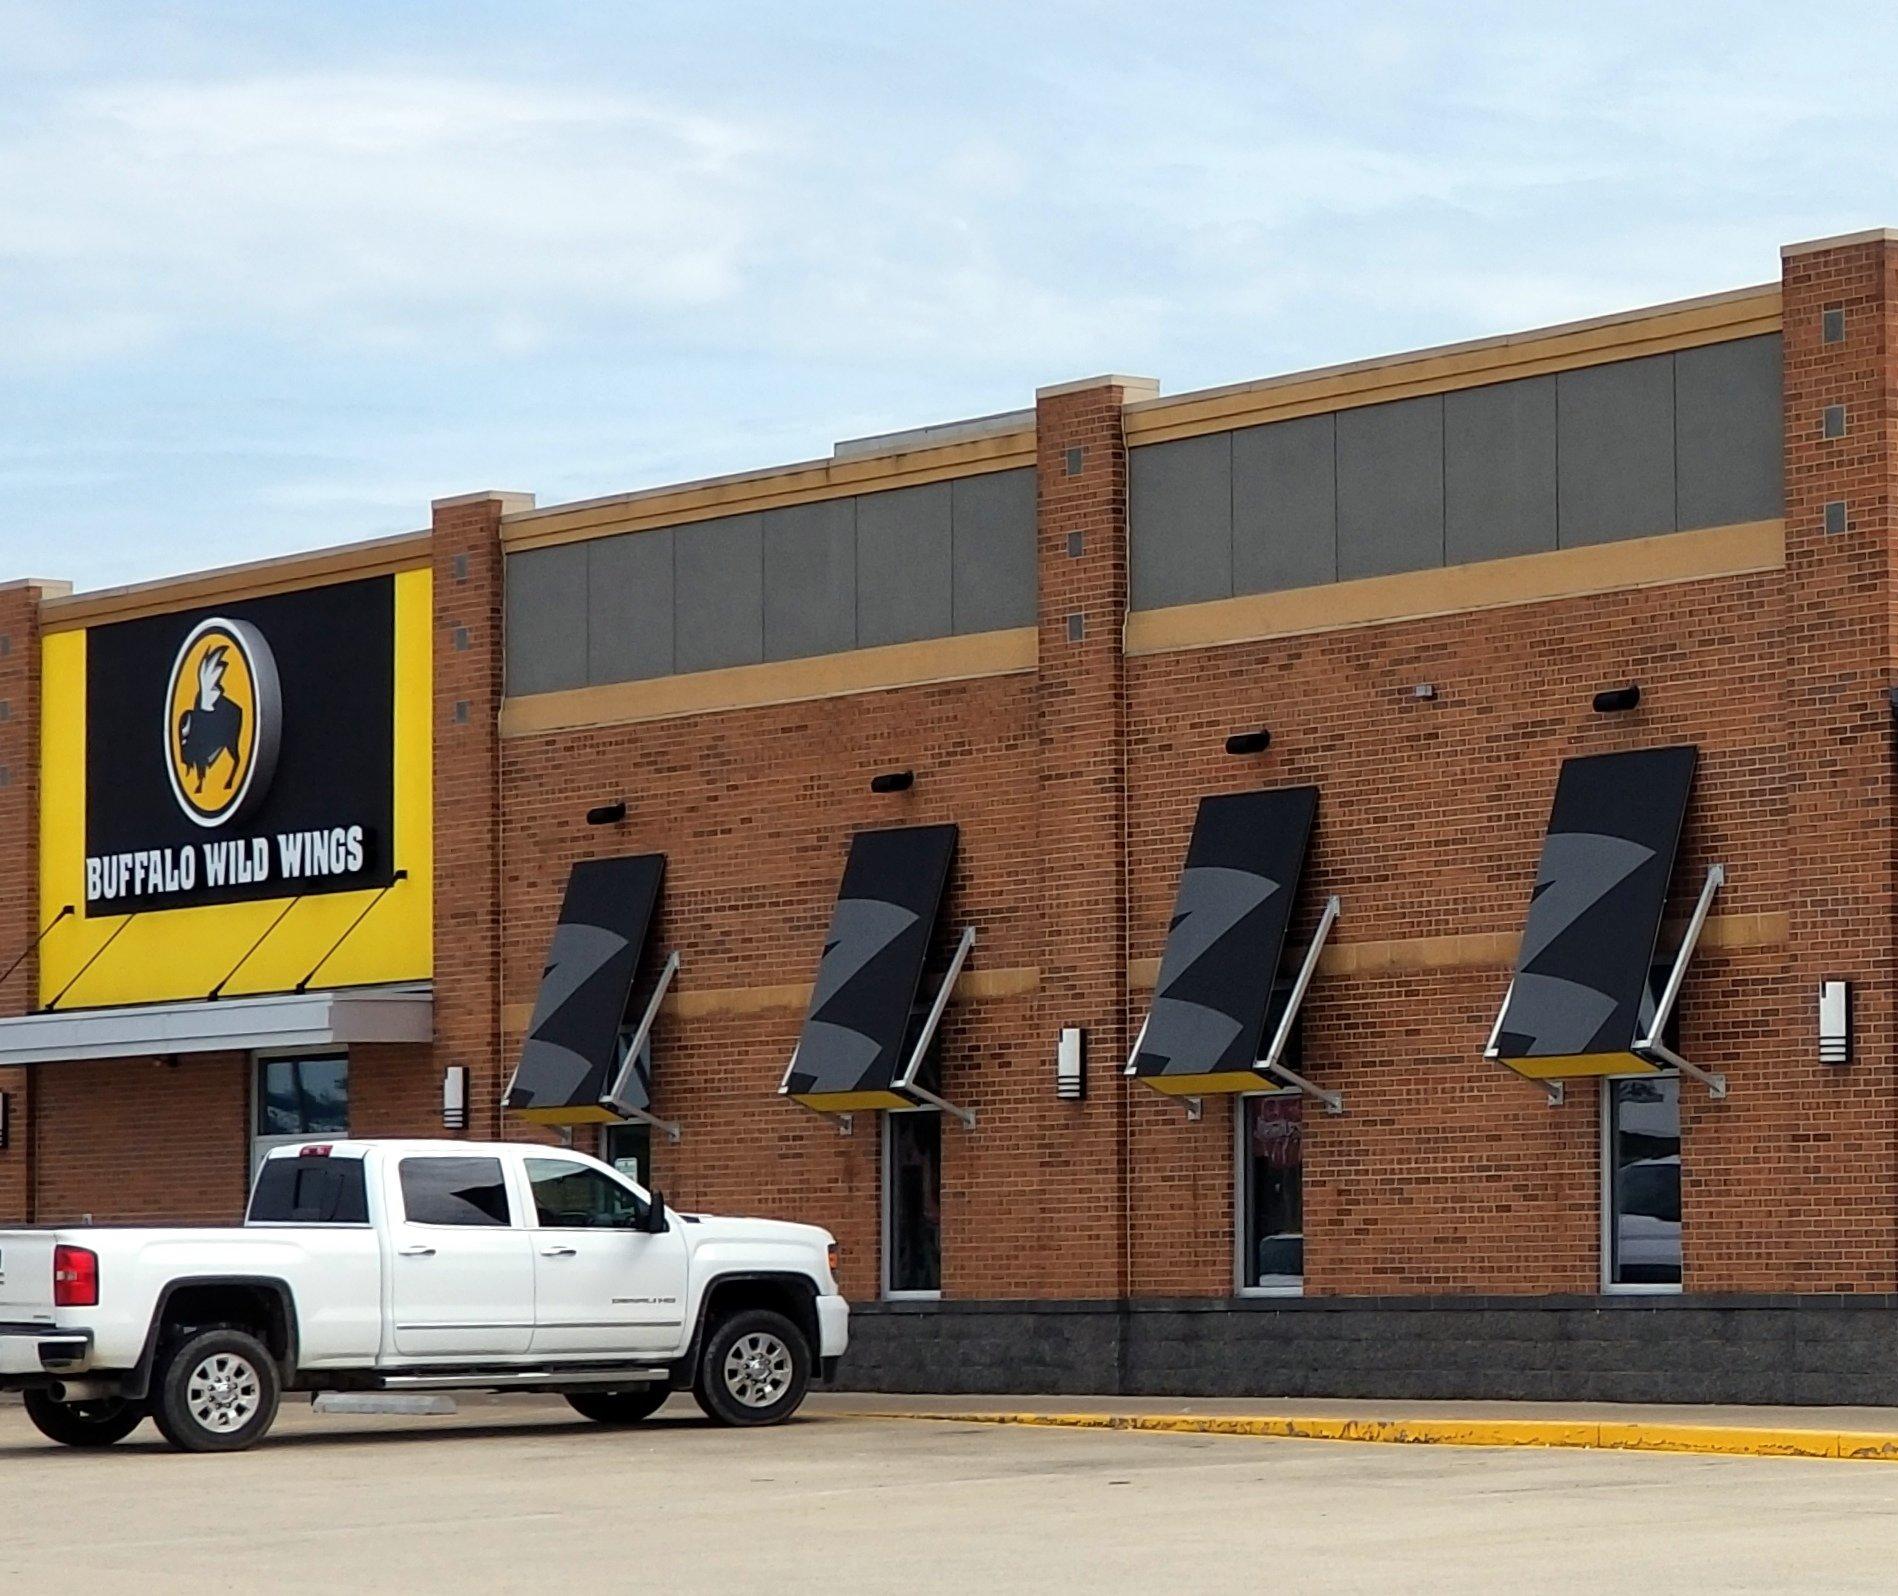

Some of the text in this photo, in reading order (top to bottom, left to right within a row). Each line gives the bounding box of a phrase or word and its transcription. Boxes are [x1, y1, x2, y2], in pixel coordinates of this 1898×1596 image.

[86, 825, 364, 901] BUFFALO WILD WINGS
